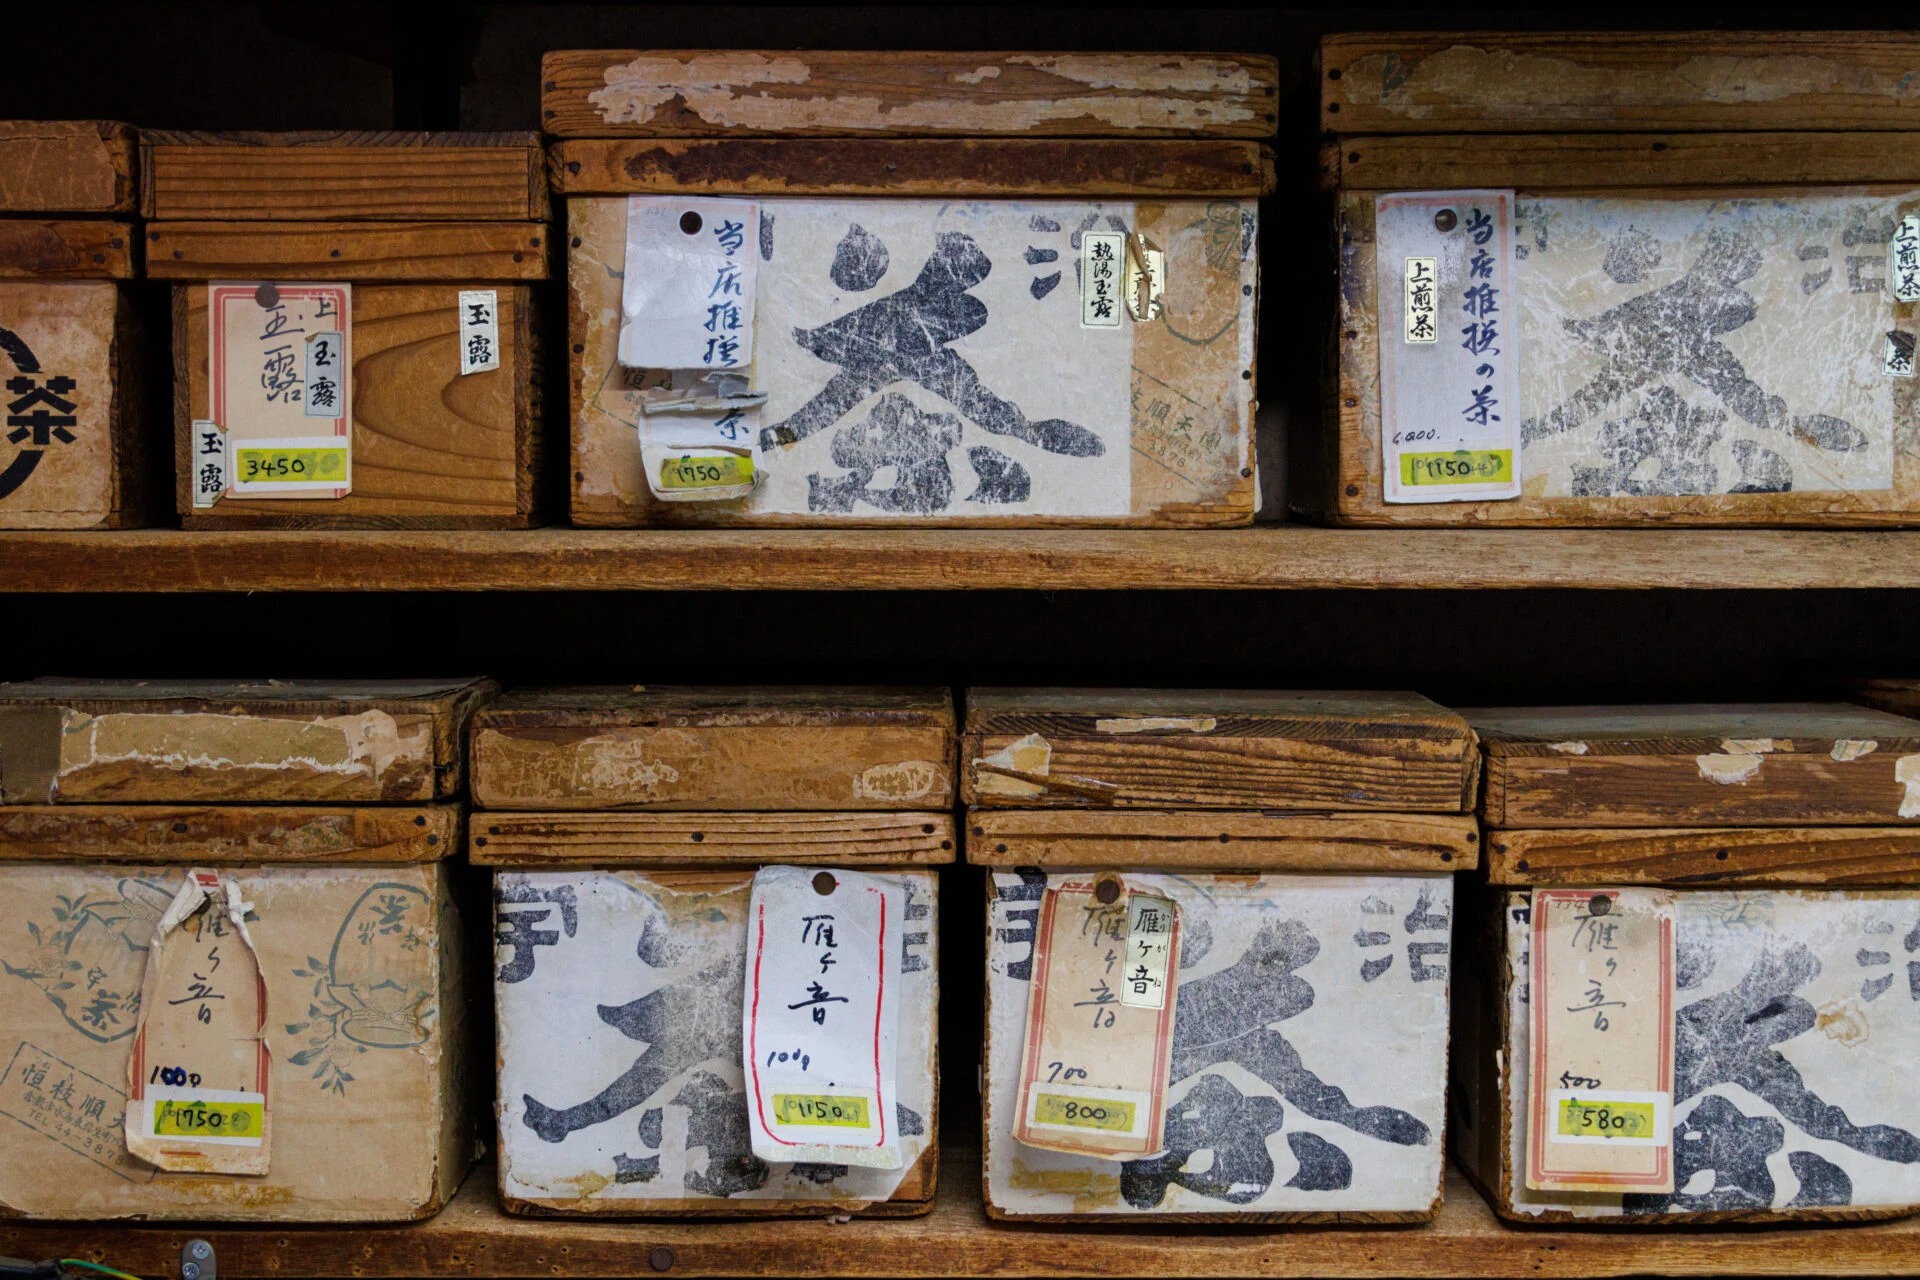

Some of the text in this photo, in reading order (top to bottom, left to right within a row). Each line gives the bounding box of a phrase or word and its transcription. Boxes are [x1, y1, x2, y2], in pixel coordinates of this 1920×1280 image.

[1895, 221, 1920, 297] 上煎茶
[313, 296, 338, 319] 上
[1409, 261, 1435, 338] 上煎茶
[466, 302, 494, 364] 玉露
[309, 340, 337, 408] 玉露
[6, 375, 78, 446] 茶
[199, 432, 224, 494] 玉露
[246, 458, 306, 476] 3450
[676, 465, 721, 483] 1750
[80, 988, 120, 1031] 茶
[1047, 1061, 1088, 1083] 700
[1559, 1070, 1602, 1090] 500
[28, 1108, 49, 1126] TEL
[176, 1109, 222, 1128] 1750
[1065, 1101, 1107, 1120] 800
[1581, 1109, 1625, 1130] 580
